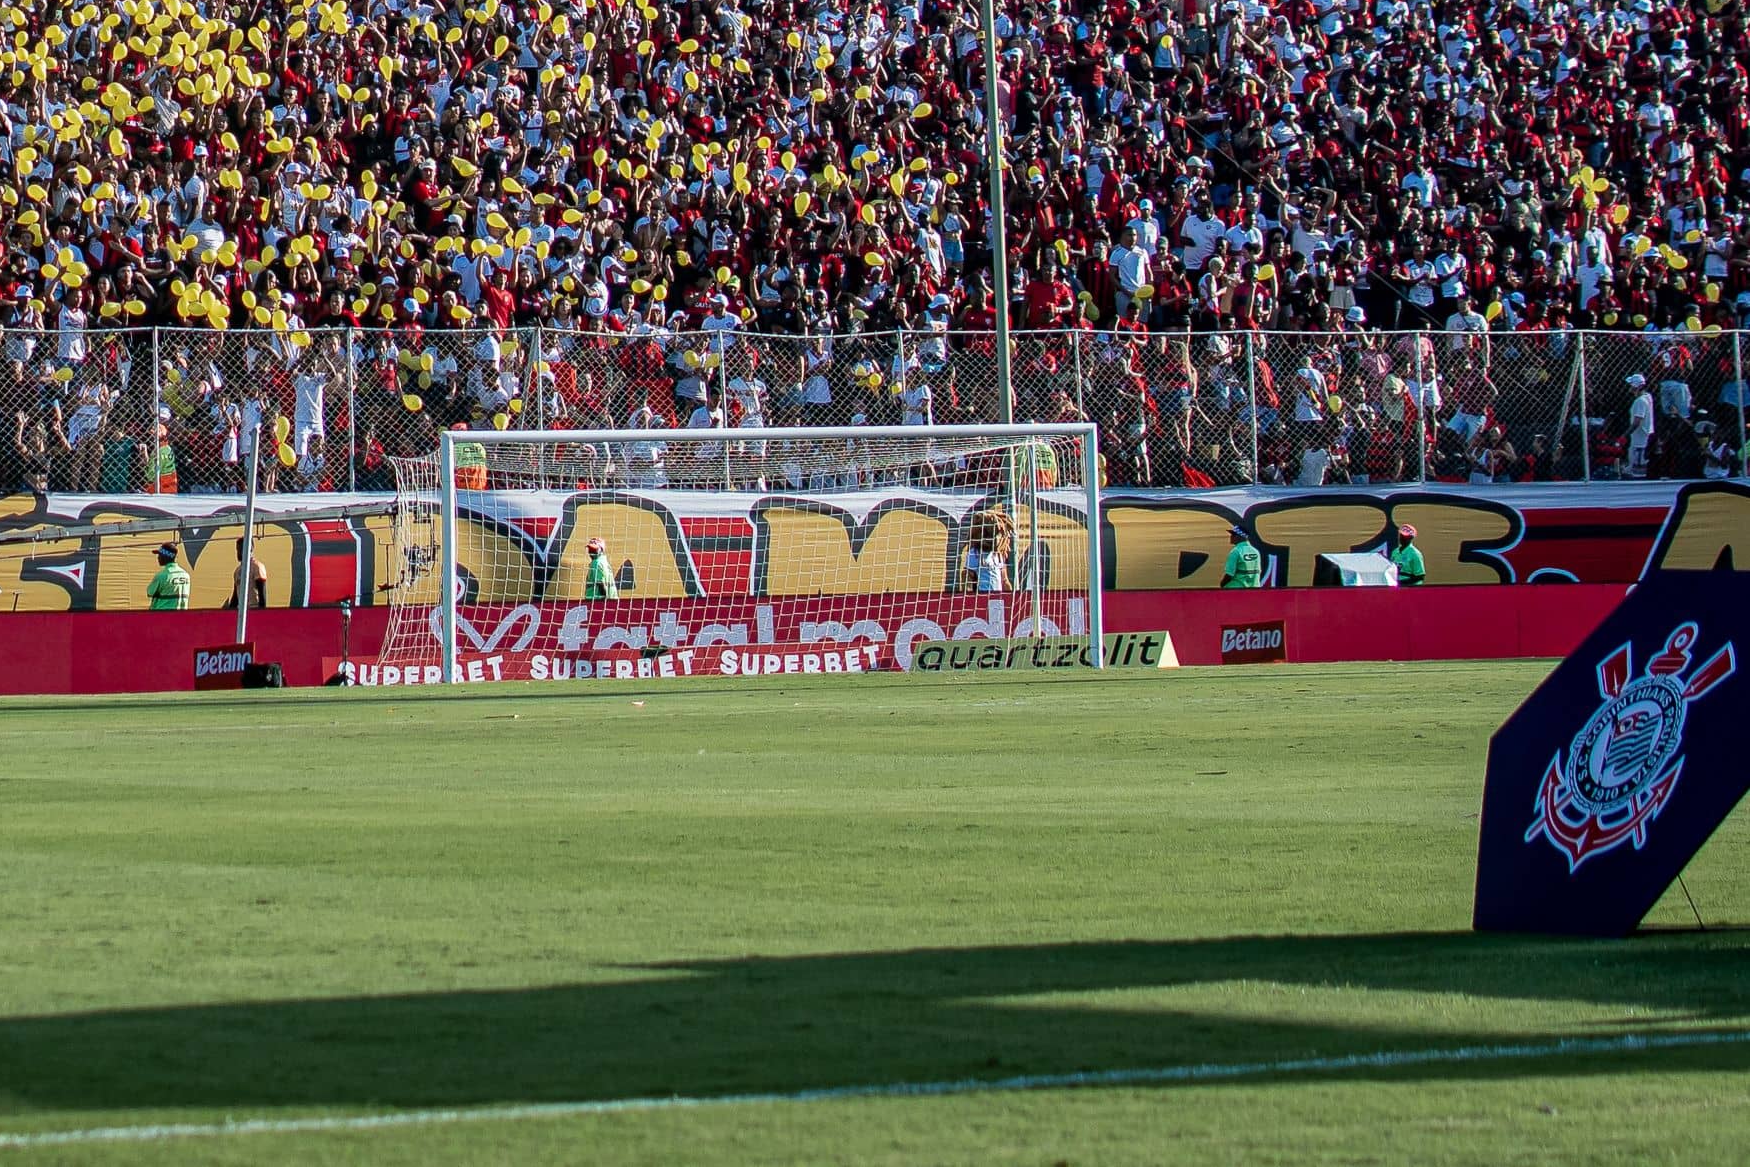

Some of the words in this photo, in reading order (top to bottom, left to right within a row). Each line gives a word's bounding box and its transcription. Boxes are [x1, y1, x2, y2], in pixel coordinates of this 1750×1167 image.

[1221, 627, 1282, 654] Betano
[720, 644, 880, 675] SUPERBET
[1585, 686, 1672, 746] CORINTHIANS
[1632, 706, 1675, 786] PAULISTA
[1590, 786, 1620, 801] 1910
